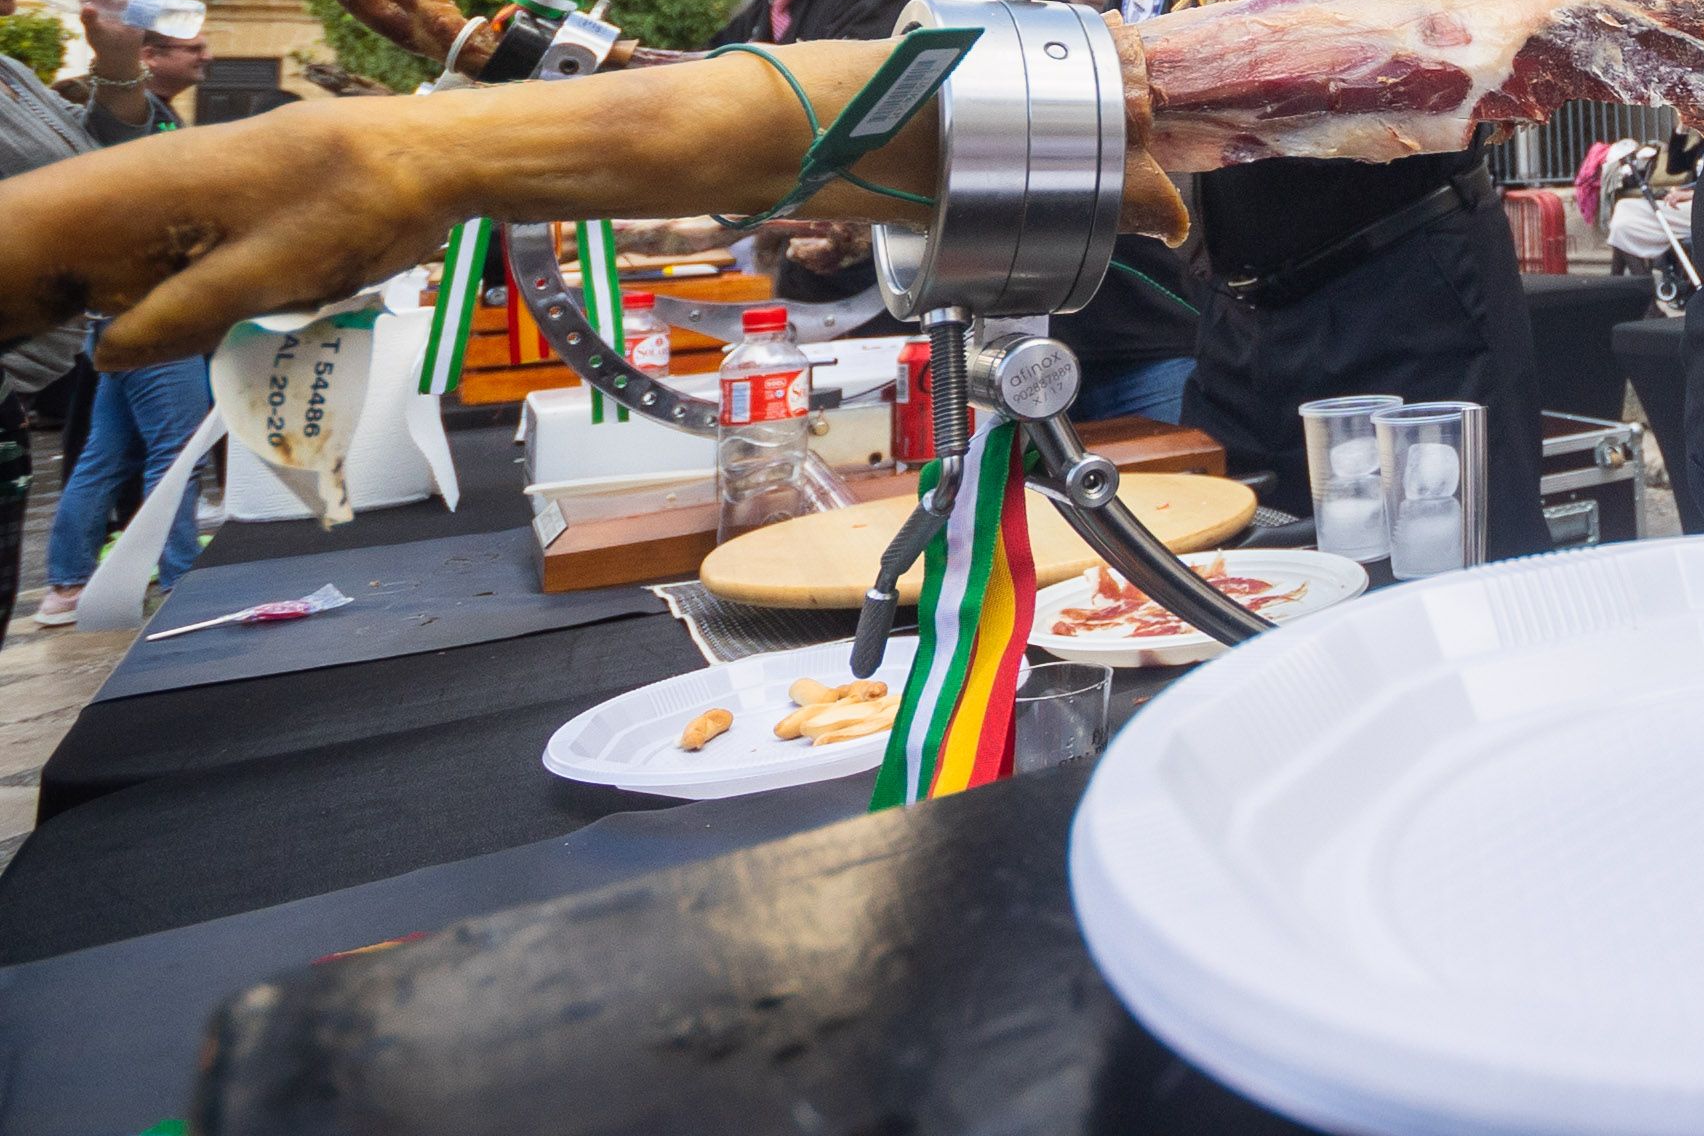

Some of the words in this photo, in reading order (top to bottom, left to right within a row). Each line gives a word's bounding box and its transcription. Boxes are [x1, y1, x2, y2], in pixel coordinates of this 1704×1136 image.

[321, 337, 342, 354] T
[1010, 351, 1062, 387] afinox
[268, 375, 289, 447] 20-20
[304, 362, 334, 437] 54486
